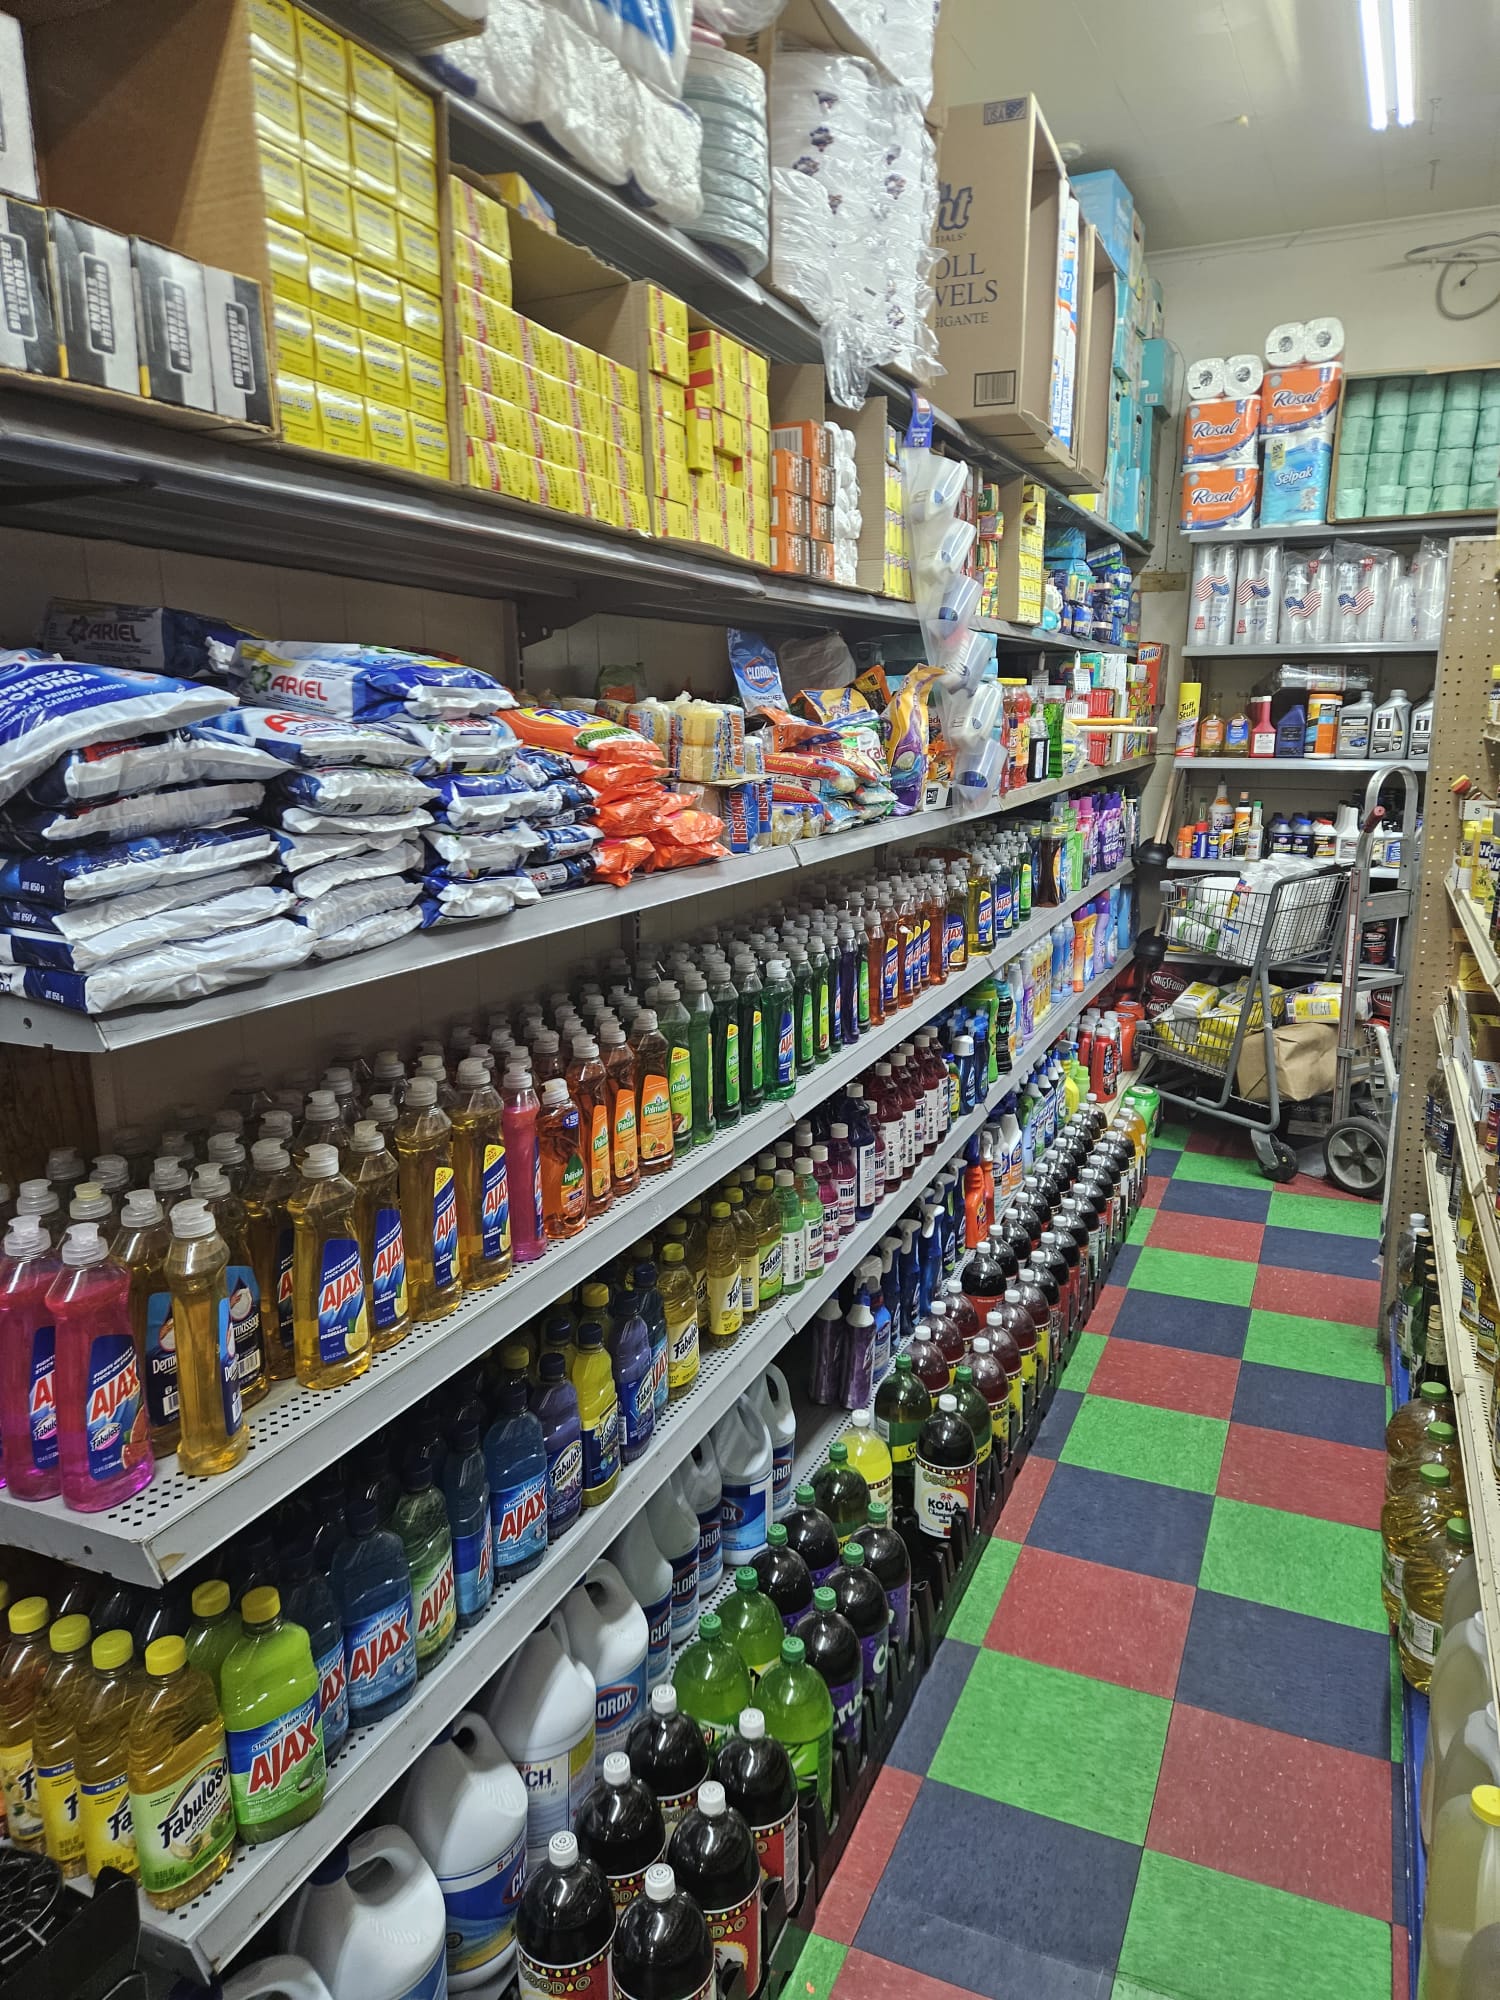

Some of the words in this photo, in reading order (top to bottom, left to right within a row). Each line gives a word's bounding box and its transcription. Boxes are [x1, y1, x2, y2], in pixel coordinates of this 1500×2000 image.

[86, 276, 101, 332] STRONG
[1273, 387, 1323, 408] Rosal
[1192, 419, 1240, 439] Rosal
[1276, 466, 1314, 486] Selpak
[1192, 487, 1240, 505] Rosal
[88, 624, 142, 643] ARIEL
[271, 674, 329, 702] ARIEL
[729, 791, 748, 844] HISPANO
[1153, 975, 1185, 991] KINGSFORD
[321, 1264, 362, 1313] AJAX
[90, 1360, 139, 1422] AJAX
[499, 1486, 547, 1543] AJAX
[928, 1498, 961, 1514] KOLA
[349, 1611, 411, 1682] AJAX
[251, 1726, 284, 1752] STRONGER
[284, 1715, 301, 1731] THAN
[249, 1712, 319, 1795] AJAX
[157, 1755, 229, 1849] Fabuloso
